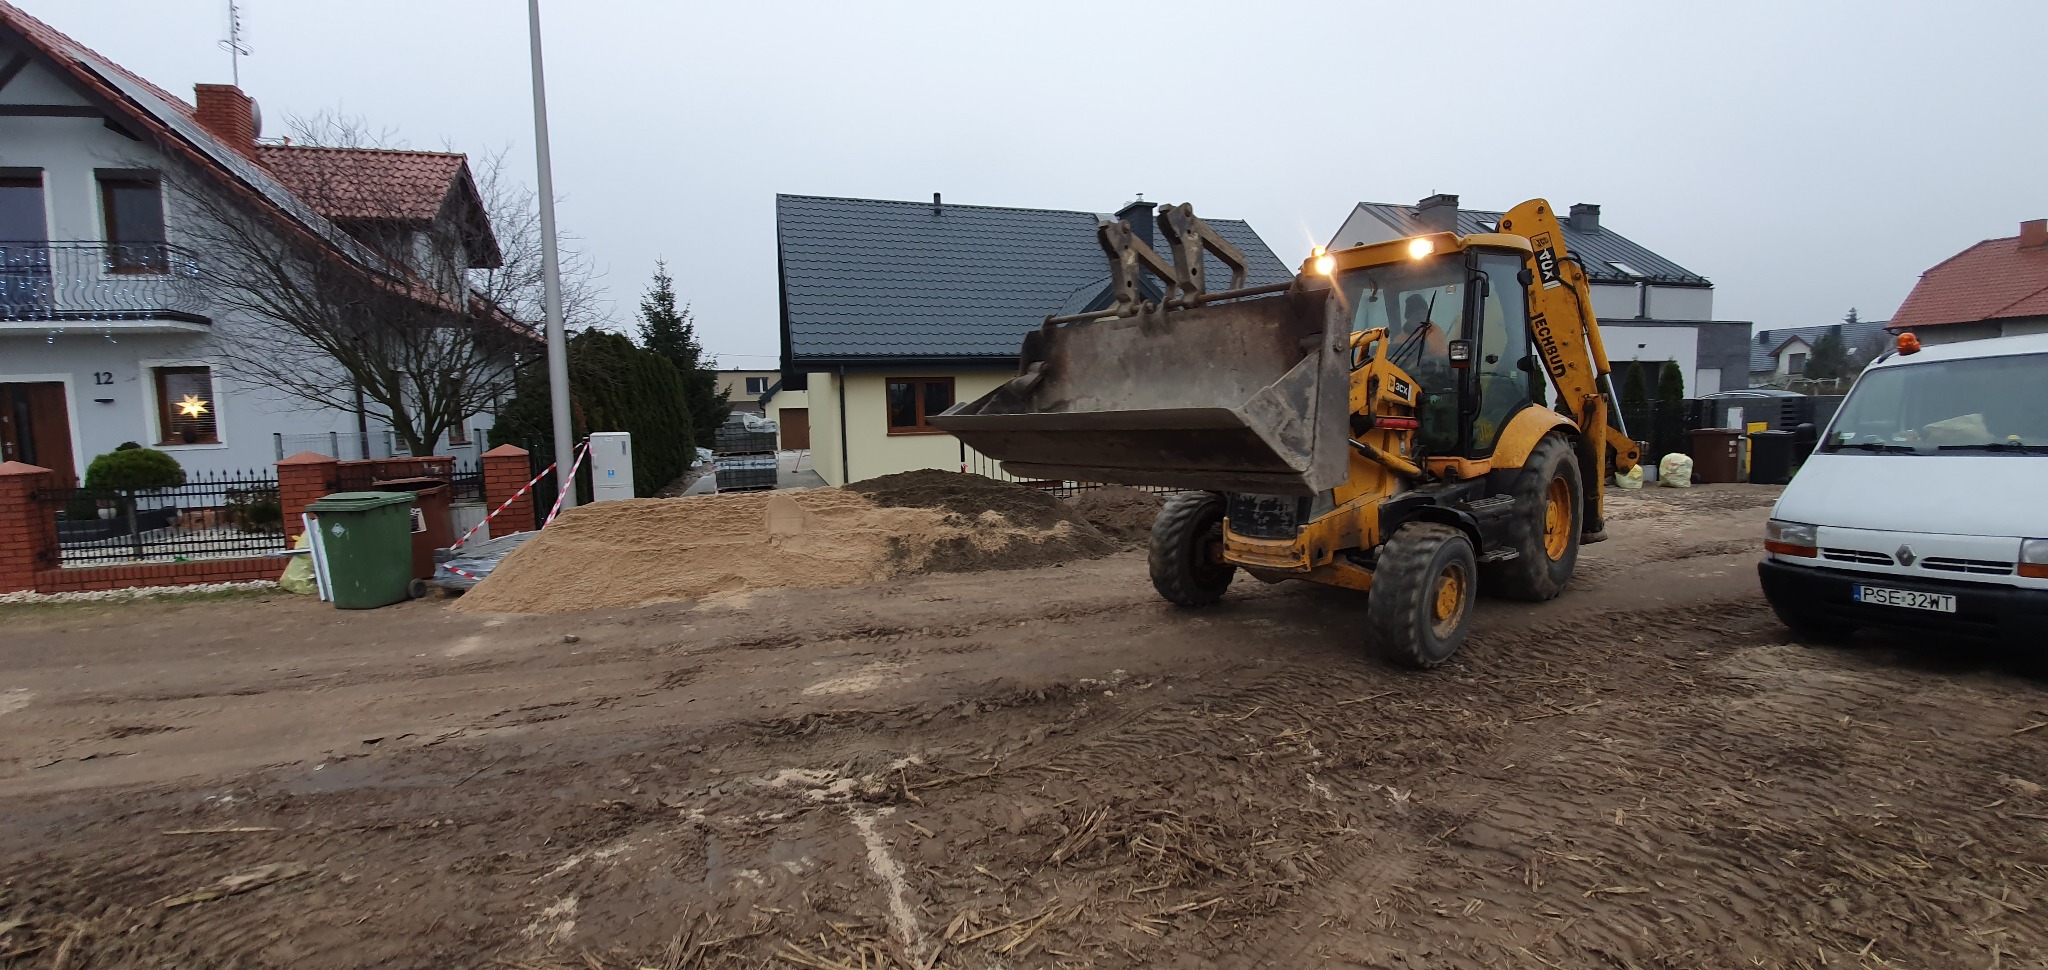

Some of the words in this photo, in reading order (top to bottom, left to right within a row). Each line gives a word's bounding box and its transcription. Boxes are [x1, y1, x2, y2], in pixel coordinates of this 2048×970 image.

[1539, 248, 1555, 280] 4CX
[94, 371, 114, 385] 12
[1395, 382, 1409, 396] 3CX
[1863, 587, 1901, 605] PSE
[1907, 592, 1953, 610] 32WT
